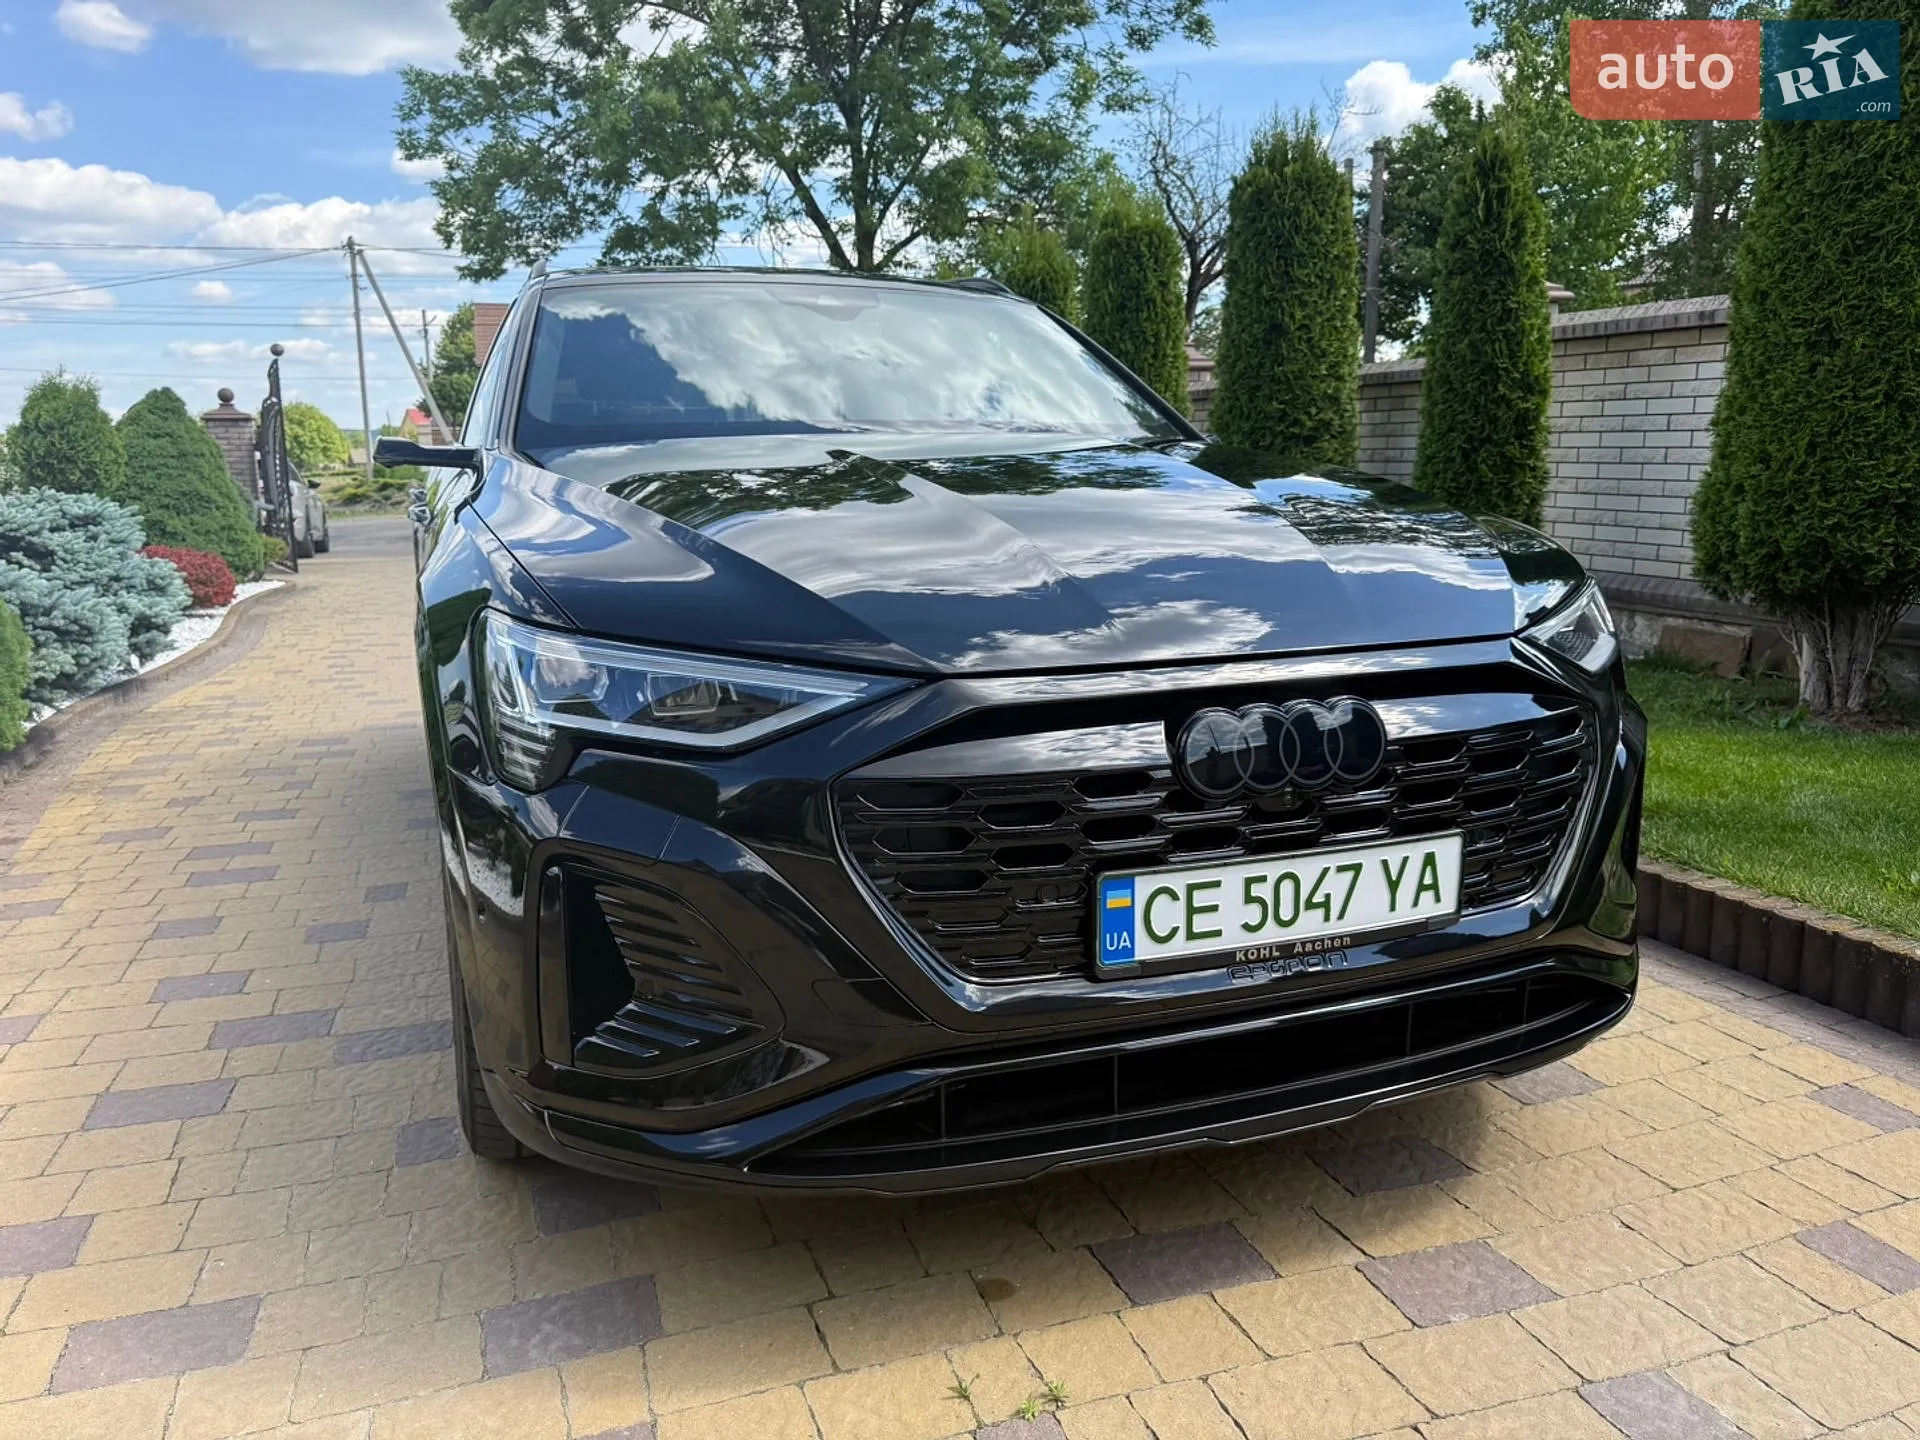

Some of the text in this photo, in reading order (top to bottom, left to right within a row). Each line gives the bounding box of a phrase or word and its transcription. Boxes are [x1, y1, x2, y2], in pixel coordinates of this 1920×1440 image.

[1143, 850, 1442, 944] CE 5047 YA
[1105, 930, 1132, 951] UA
[1235, 935, 1351, 962] KOHL Aachen
